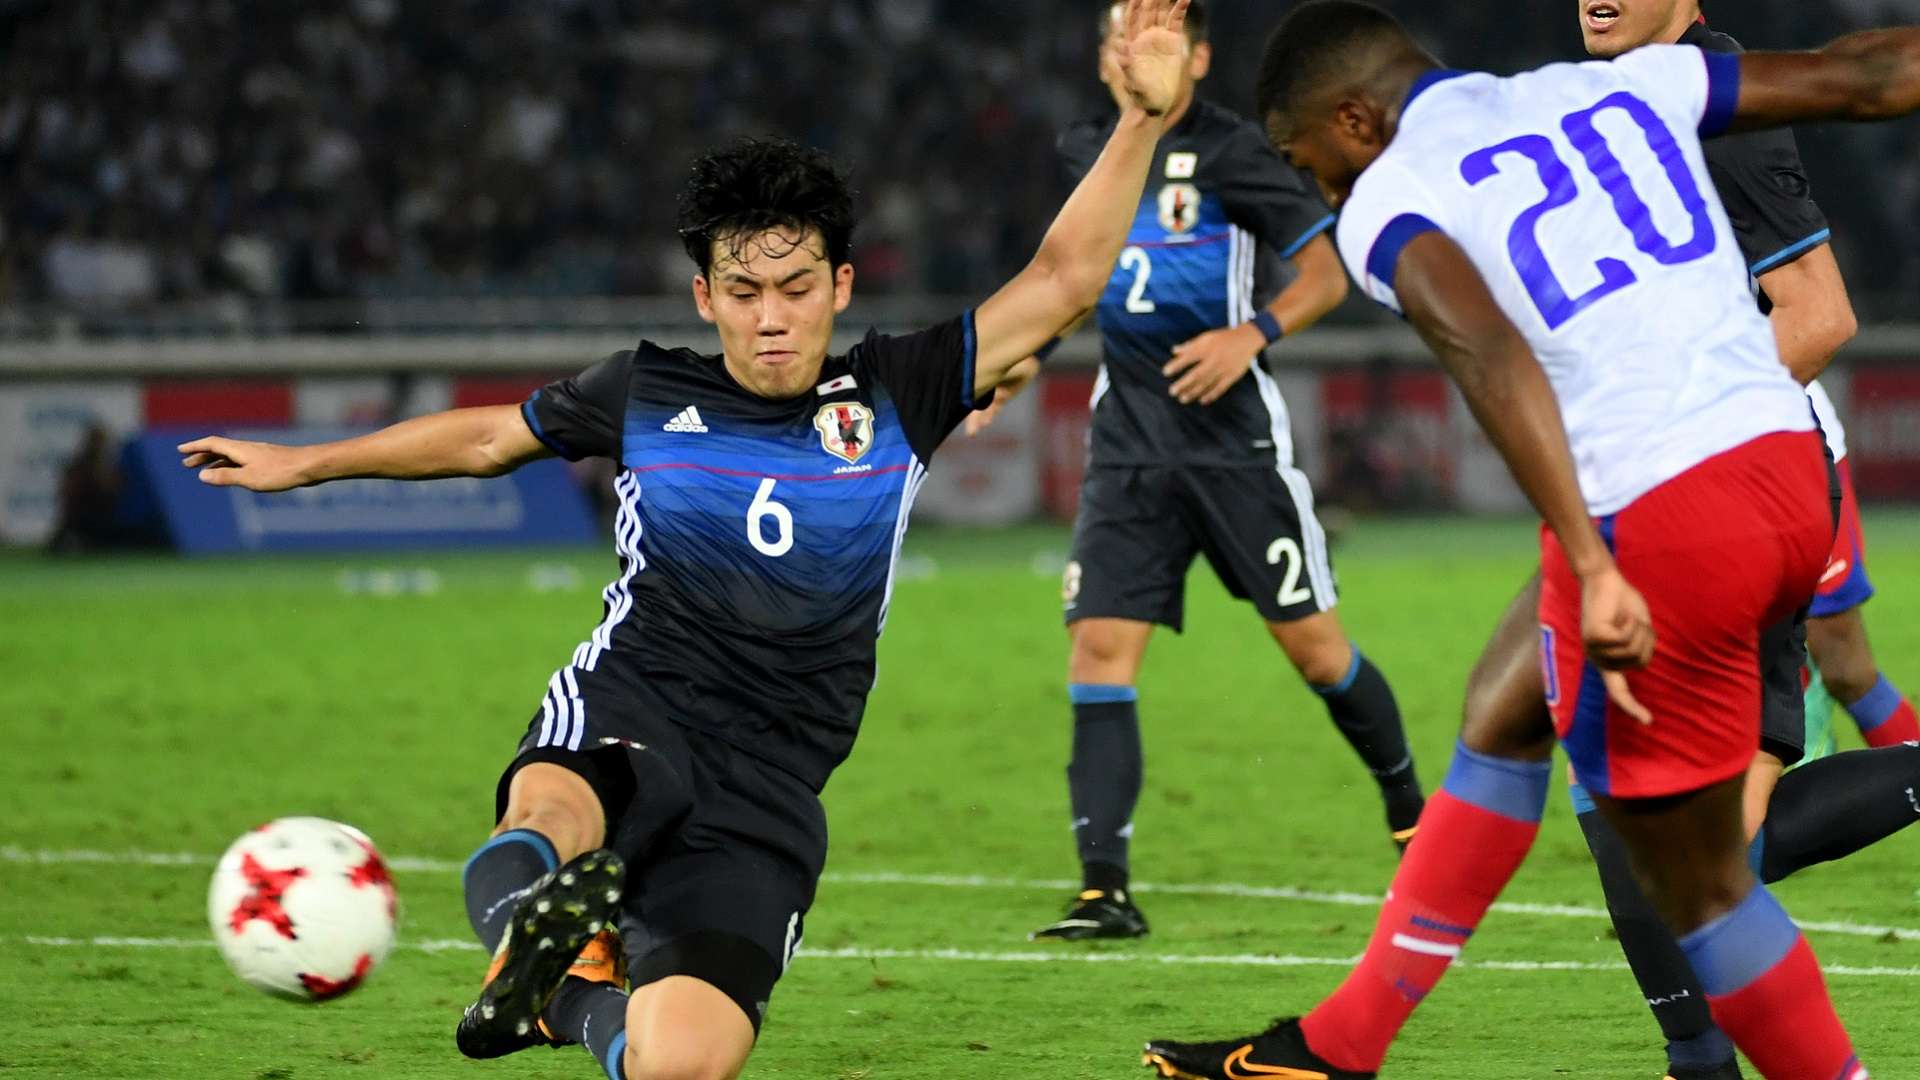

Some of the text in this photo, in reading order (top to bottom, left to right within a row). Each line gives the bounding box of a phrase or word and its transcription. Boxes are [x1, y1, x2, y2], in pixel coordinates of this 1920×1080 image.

[1460, 91, 1716, 330] 20
[1120, 246, 1156, 313] 2
[663, 423, 709, 433] adidas
[833, 464, 872, 474] JAPAN
[746, 478, 793, 557] 6
[1266, 537, 1312, 607] 2
